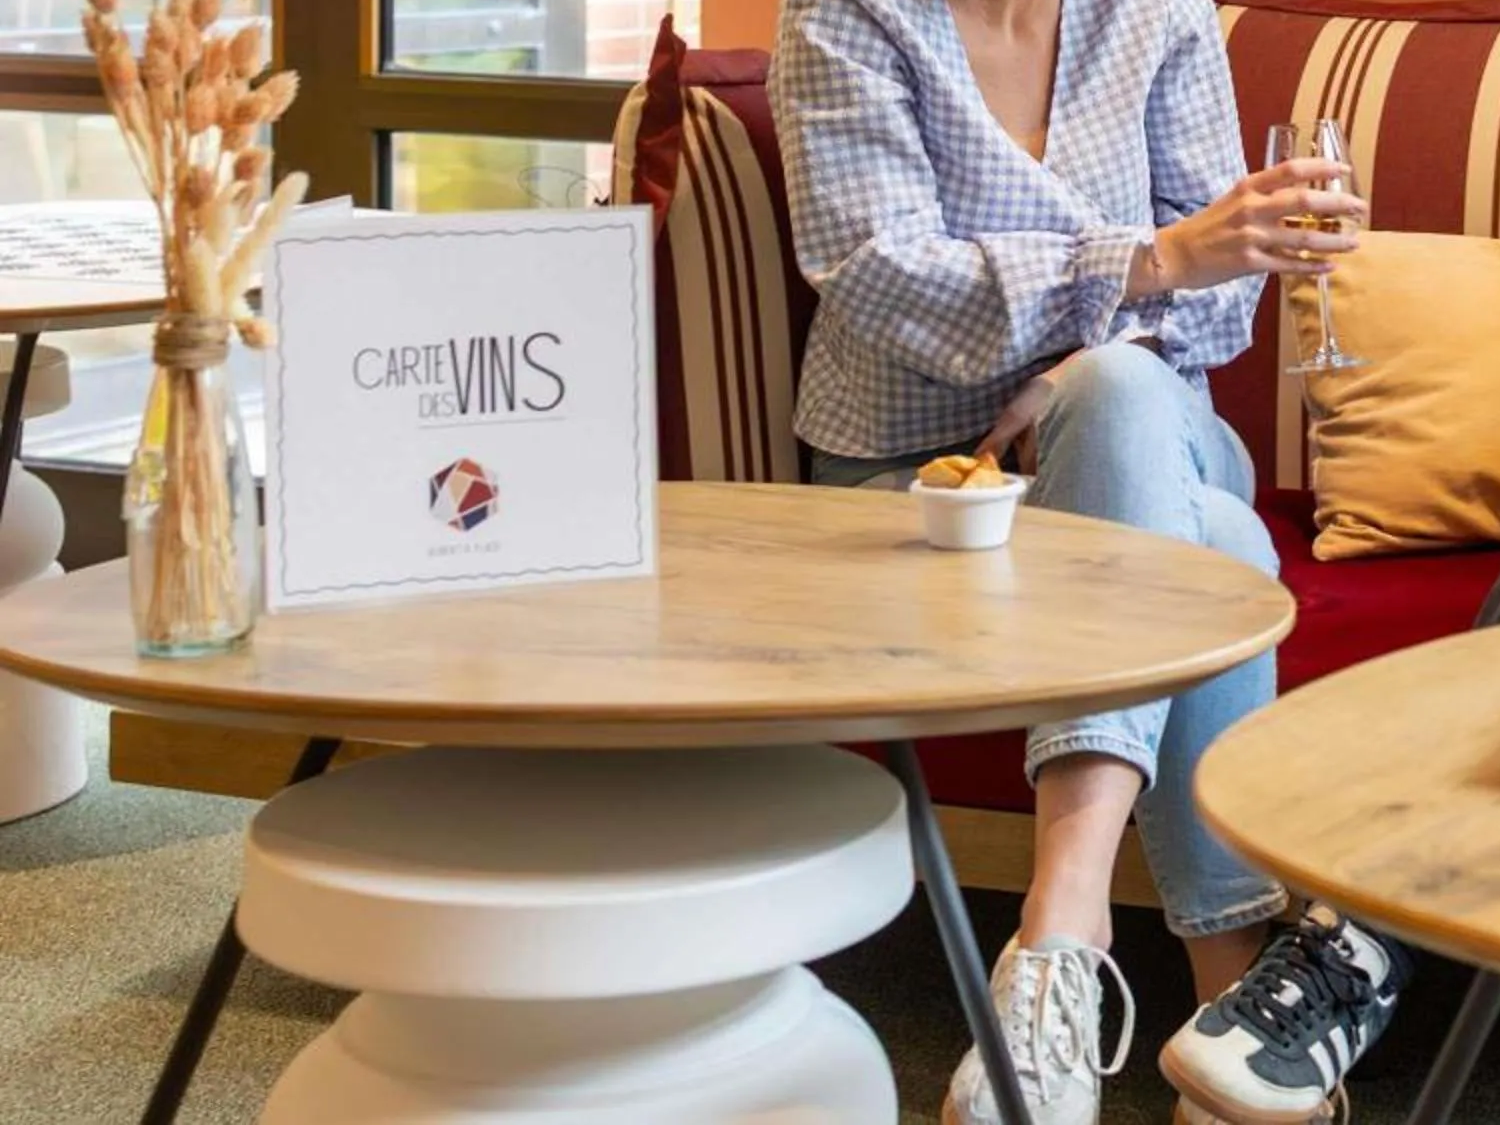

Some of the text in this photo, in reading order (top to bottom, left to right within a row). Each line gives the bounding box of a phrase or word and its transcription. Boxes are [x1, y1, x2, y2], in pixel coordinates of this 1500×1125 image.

[352, 343, 447, 390] CARTE
[449, 332, 566, 415] VINS
[418, 392, 457, 419] DES
